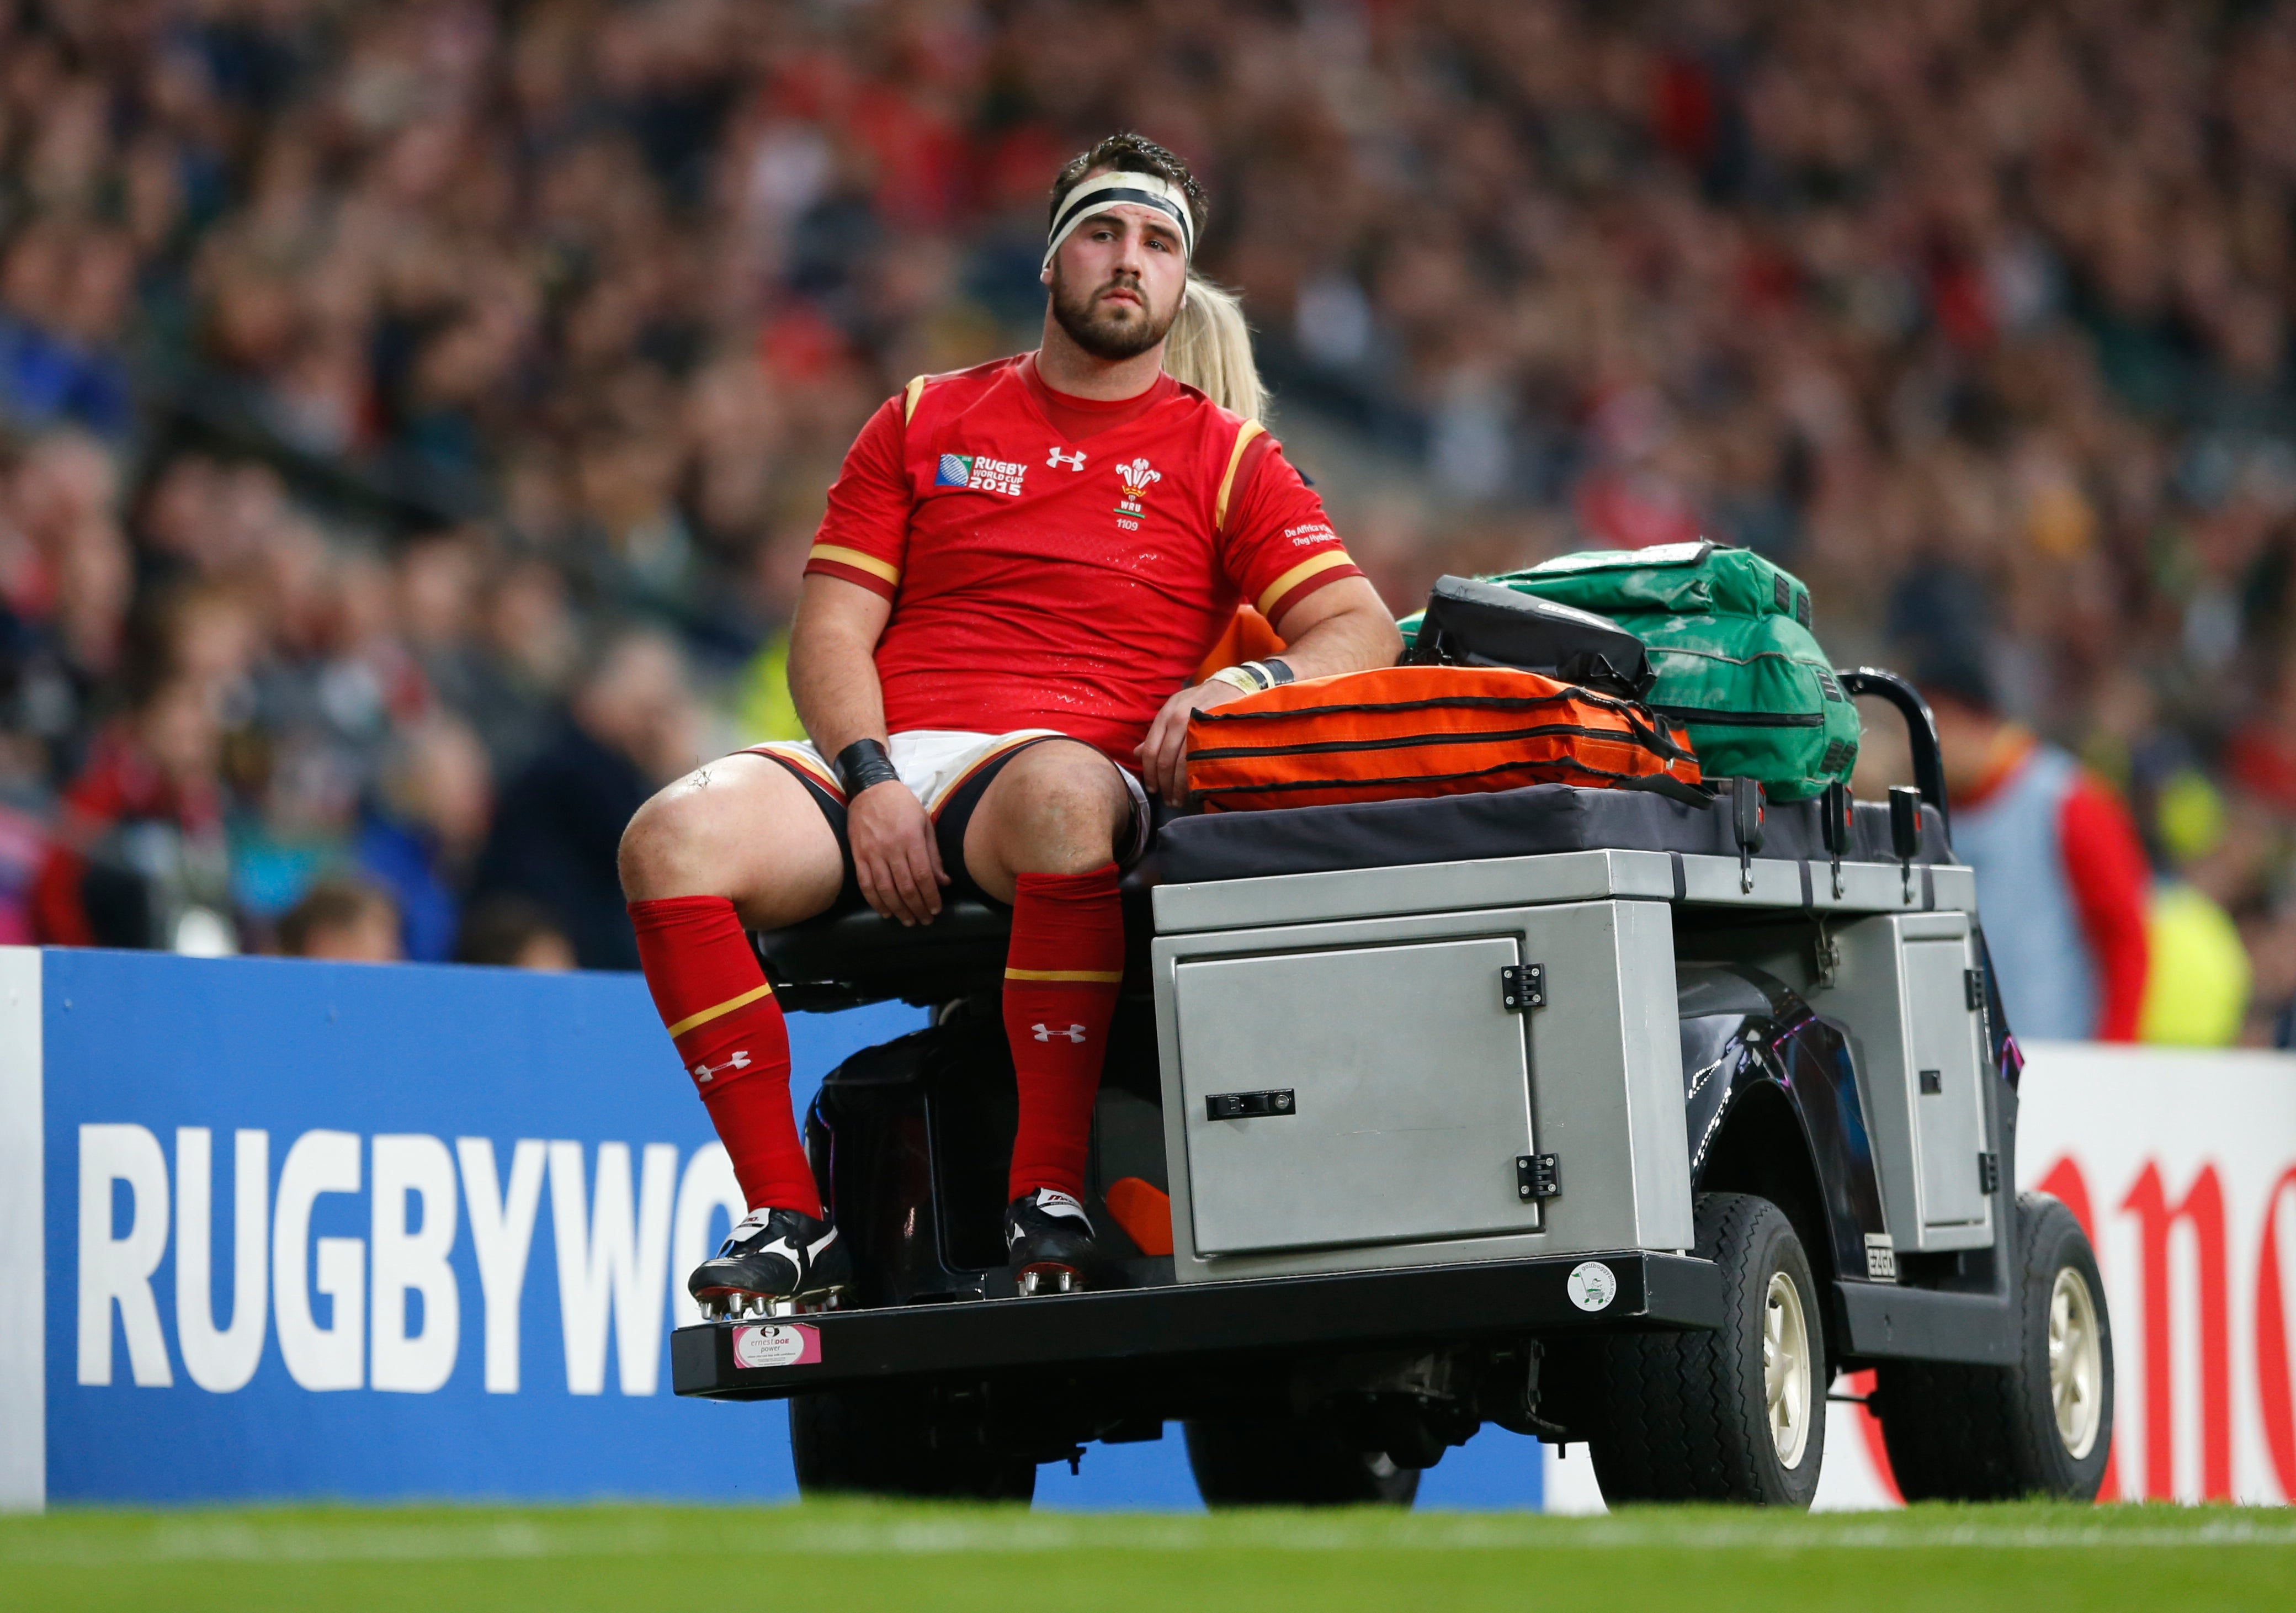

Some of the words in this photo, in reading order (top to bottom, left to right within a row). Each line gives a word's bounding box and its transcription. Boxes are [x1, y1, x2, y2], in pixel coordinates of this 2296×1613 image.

[974, 456, 1027, 476] RUGBY
[973, 469, 1005, 481] WORLD
[1005, 475, 1024, 484] CUP
[969, 476, 1022, 496] 2015
[1120, 500, 1141, 512] WRU
[1117, 518, 1138, 531] 1109
[1284, 529, 1296, 538] De
